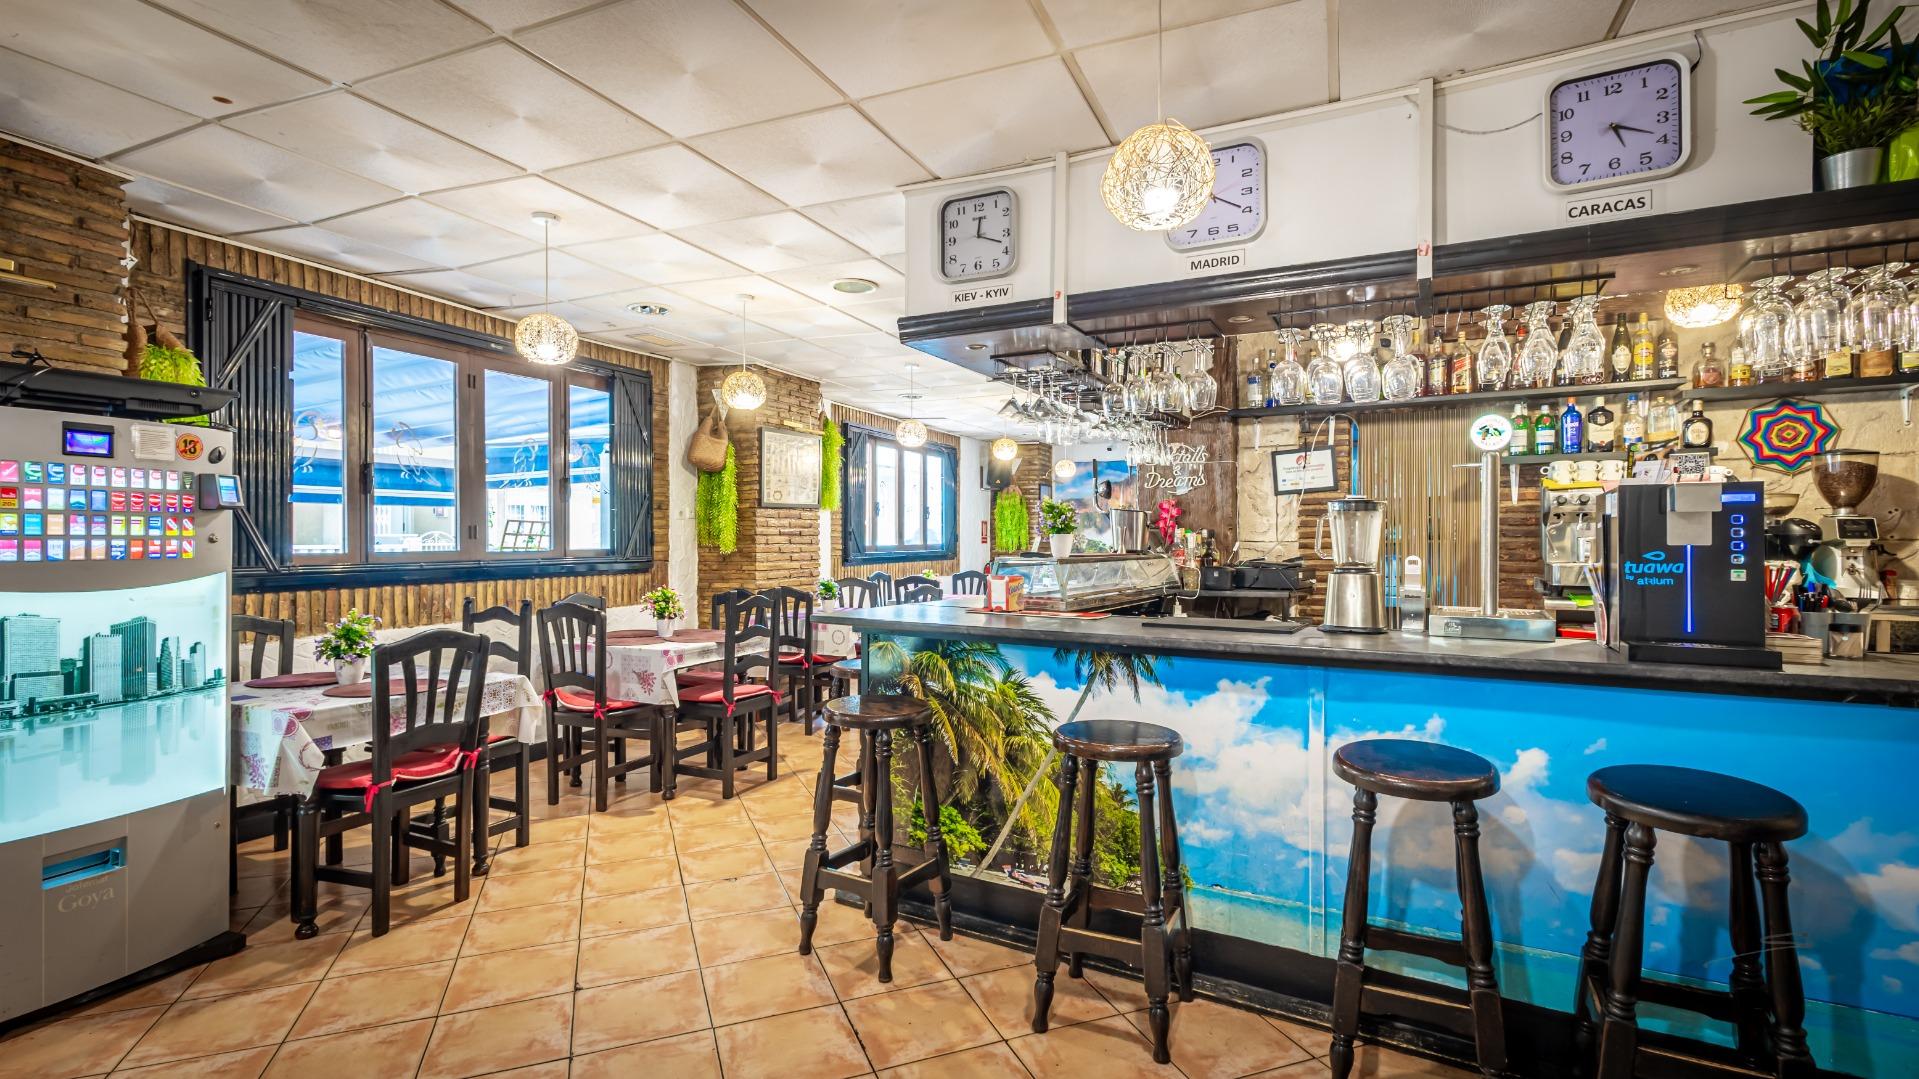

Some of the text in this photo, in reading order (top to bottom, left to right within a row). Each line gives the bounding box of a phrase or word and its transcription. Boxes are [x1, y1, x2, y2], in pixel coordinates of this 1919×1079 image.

[1641, 77, 1648, 88] 1
[1603, 82, 1623, 96] 12
[1656, 88, 1669, 101] 2
[1576, 90, 1590, 103] 11
[1558, 108, 1574, 121] 10
[1656, 111, 1669, 123] 3
[1560, 131, 1572, 142] 9
[1655, 133, 1670, 144] 4
[1231, 155, 1235, 163] 1
[1561, 152, 1573, 164] 8
[1608, 157, 1621, 170] 6
[1640, 151, 1653, 165] 5
[1241, 168, 1253, 177] 2
[1579, 163, 1591, 175] 7
[1241, 186, 1253, 195] 3
[957, 206, 966, 215] 11
[974, 202, 985, 212] 12
[1002, 207, 1010, 216] 2
[1568, 197, 1646, 218] CARACAS
[949, 220, 958, 229] 10
[1227, 224, 1239, 232] 5
[1002, 228, 1010, 237] 3
[1186, 229, 1198, 238] 7
[1208, 227, 1220, 235] 6
[948, 236, 957, 246] 9
[1001, 246, 1009, 255] 4
[949, 254, 957, 264] 8
[992, 259, 1000, 267] 5
[1191, 255, 1240, 270] MADRID
[960, 263, 967, 273] 7
[974, 260, 982, 270] 6
[954, 291, 977, 302] KIEV
[985, 288, 1009, 298] KYIV
[183, 439, 197, 454] 18
[1173, 464, 1182, 475] &
[1145, 472, 1206, 488] Dreams
[1624, 561, 1685, 574] tuawa
[1637, 577, 1674, 585] atrium
[58, 888, 115, 913] Goya
